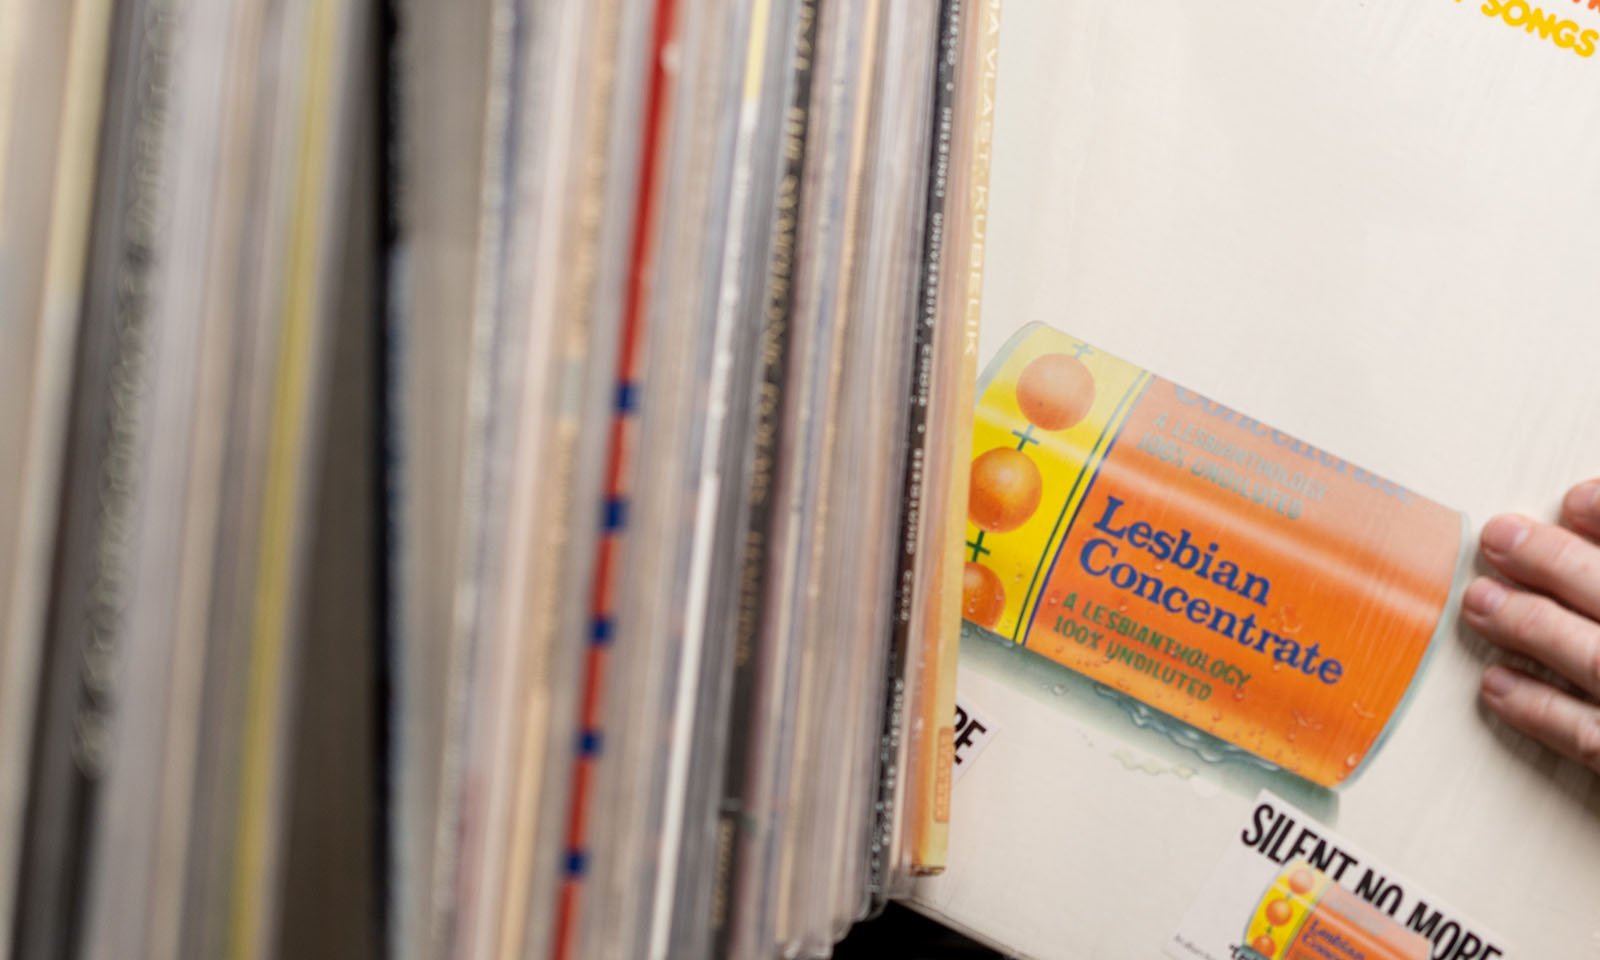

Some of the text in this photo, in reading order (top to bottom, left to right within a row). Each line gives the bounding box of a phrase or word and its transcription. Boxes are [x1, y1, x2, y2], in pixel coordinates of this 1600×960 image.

[1153, 411, 1169, 429] A
[1190, 456, 1305, 520] UNDILUTED
[1093, 496, 1271, 607] Lesbian
[1054, 615, 1213, 701] 100% UNDILUTED
[1062, 591, 1252, 689] A LESBIANTHOLOGY
[1079, 538, 1343, 685] Concentrate
[1241, 803, 1359, 883] SILENT
[1354, 868, 1404, 918] NO
